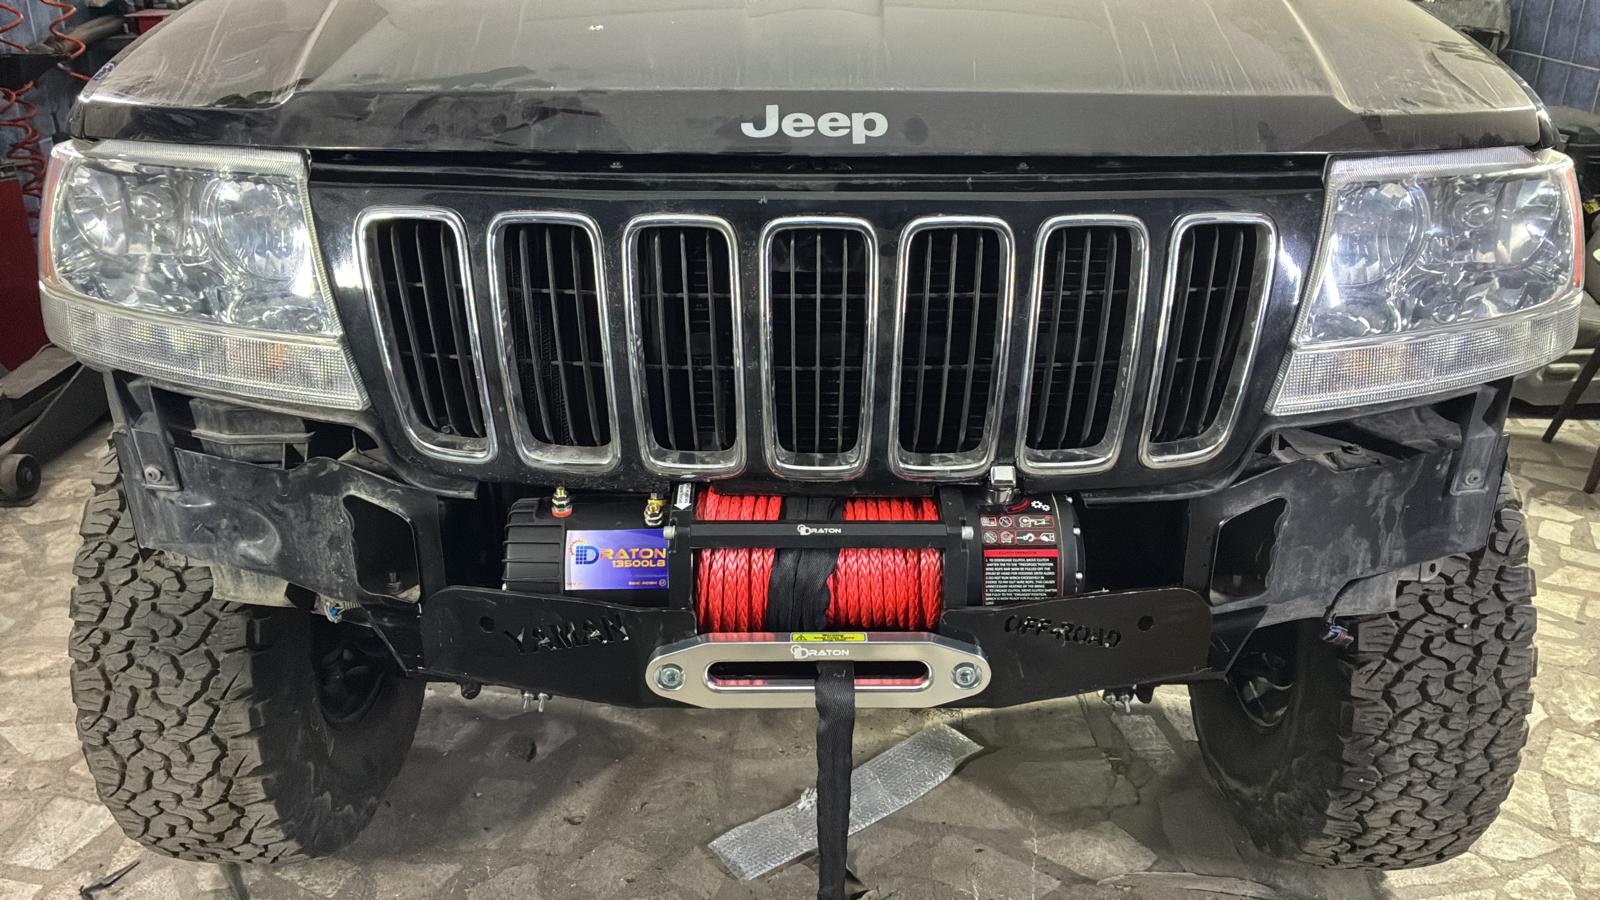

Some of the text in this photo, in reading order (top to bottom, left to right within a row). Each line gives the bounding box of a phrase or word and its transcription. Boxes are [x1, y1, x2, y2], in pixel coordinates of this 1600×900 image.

[741, 104, 888, 145] Jeep
[799, 526, 842, 536] DRATON
[576, 546, 667, 565] DRATON
[612, 559, 666, 568] 13500LB
[504, 613, 630, 654] YAMAN
[1004, 614, 1122, 648] OFF-ROAD
[793, 646, 850, 659] DRATON
